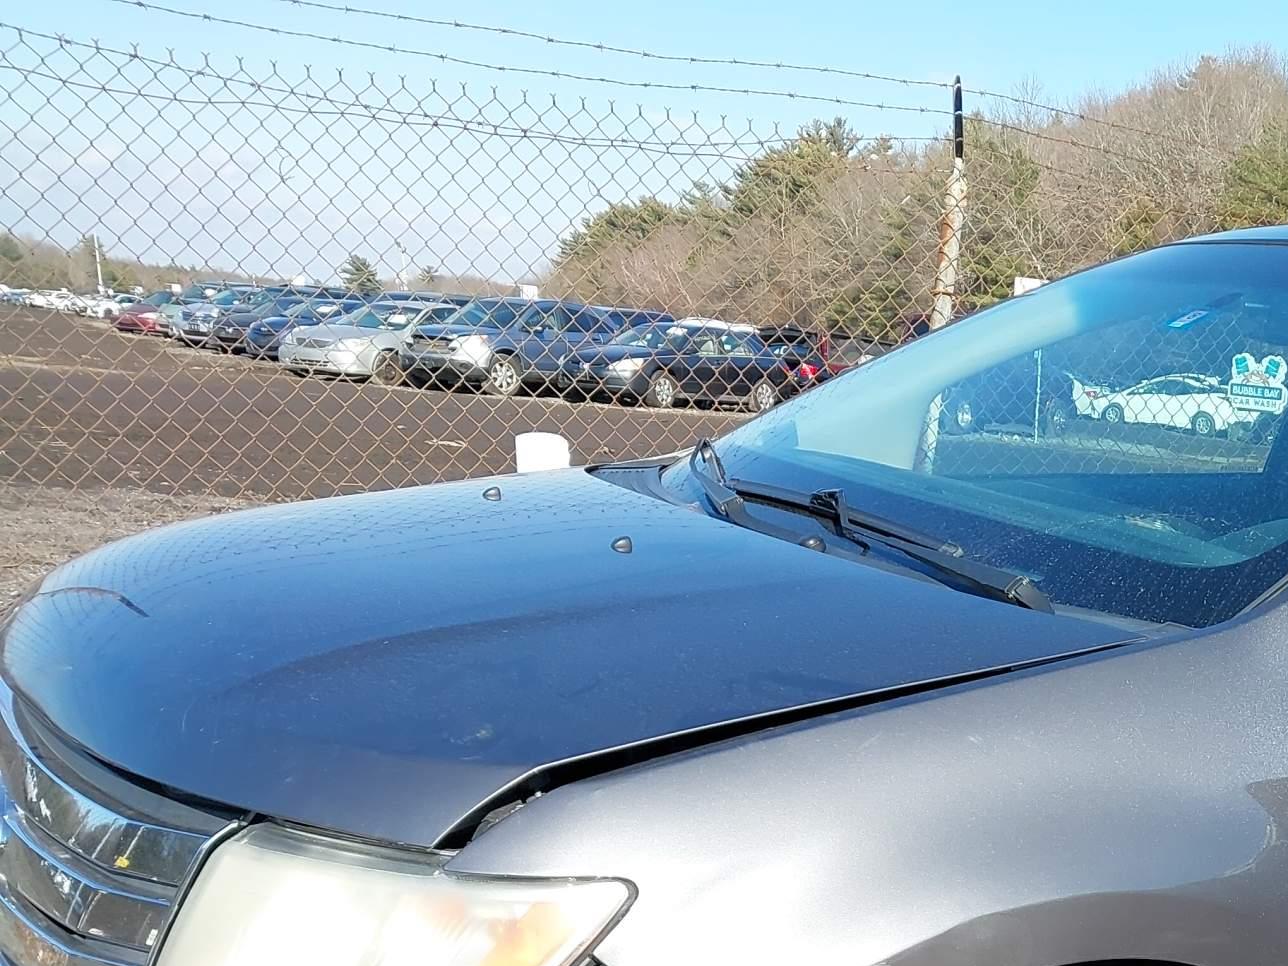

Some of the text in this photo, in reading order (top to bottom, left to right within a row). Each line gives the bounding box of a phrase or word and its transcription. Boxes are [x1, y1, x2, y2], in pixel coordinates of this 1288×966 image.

[1232, 385, 1280, 398] BUBBLE BAY
[1232, 397, 1277, 408] CAR WASH
